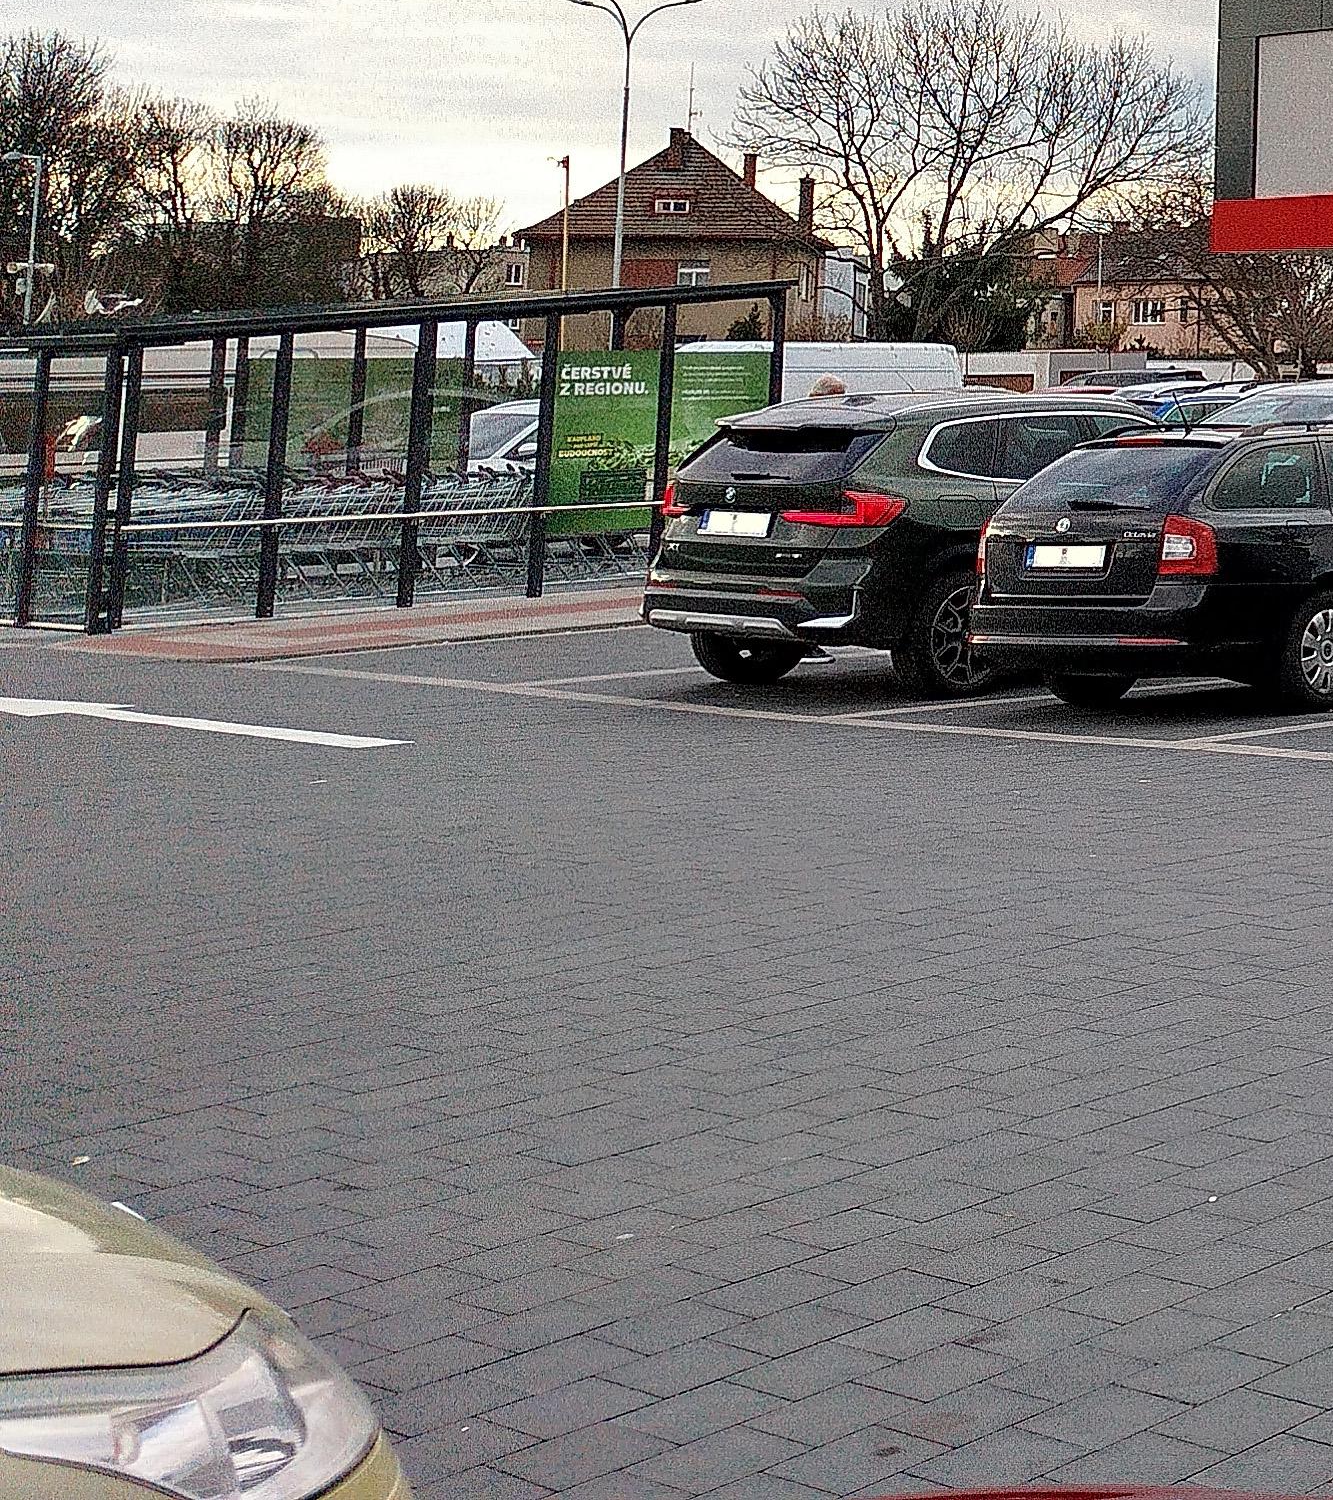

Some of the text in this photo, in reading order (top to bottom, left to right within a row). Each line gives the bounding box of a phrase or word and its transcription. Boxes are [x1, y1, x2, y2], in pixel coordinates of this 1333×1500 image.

[561, 364, 632, 380] ČERSTVÉ
[559, 381, 649, 396] Z REGIONU.
